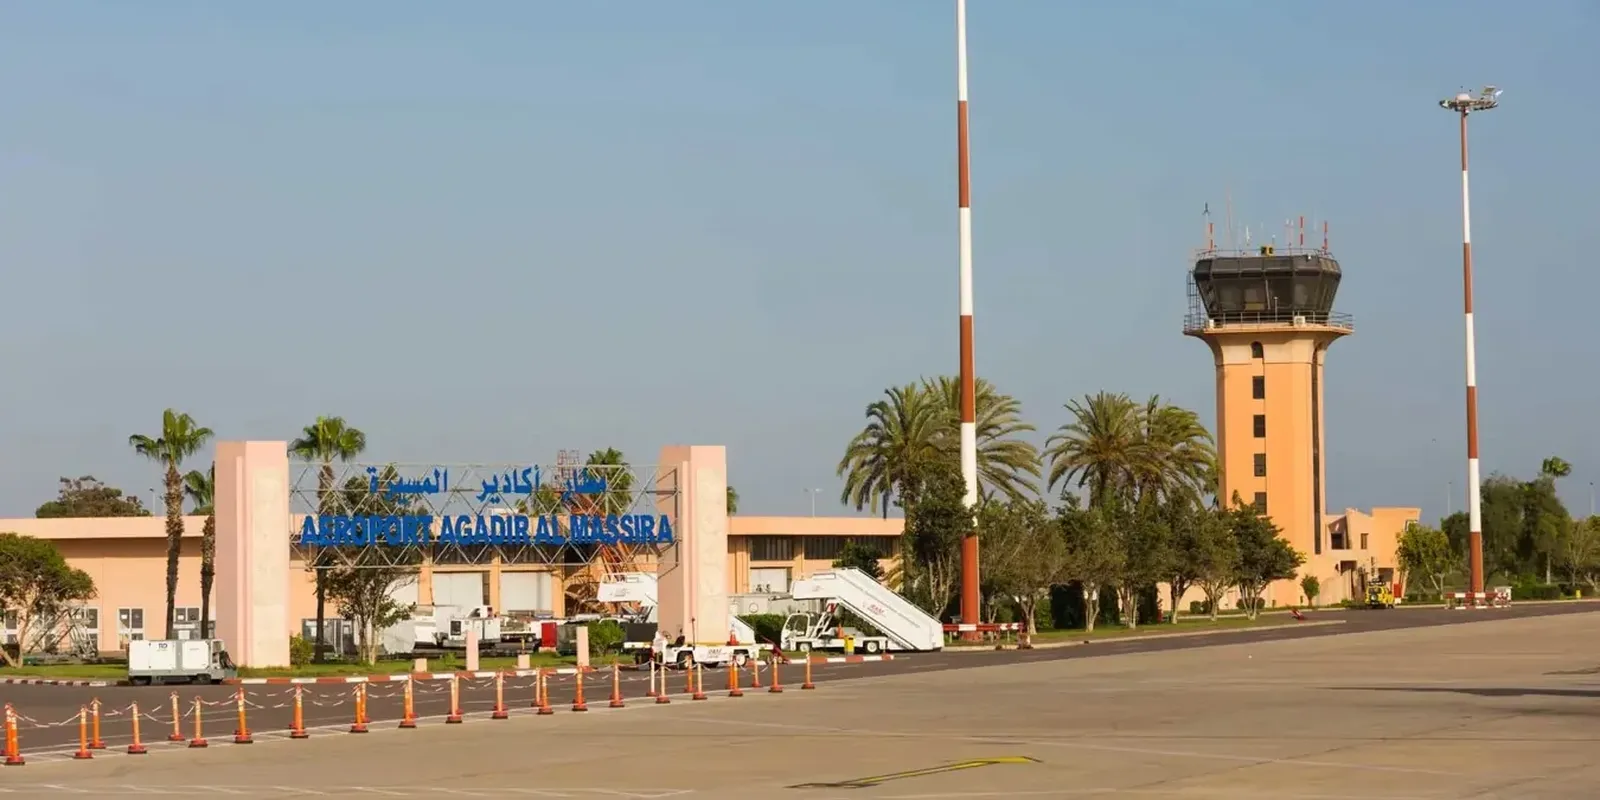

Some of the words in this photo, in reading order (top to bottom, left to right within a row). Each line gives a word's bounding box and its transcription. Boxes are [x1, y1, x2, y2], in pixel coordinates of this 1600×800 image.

[366, 467, 448, 504] المسيرة
[476, 465, 540, 504] أكادير
[562, 468, 607, 501] مطار
[300, 514, 433, 546] AEROPORT
[440, 514, 528, 545] AGADIR
[534, 514, 564, 545] AL
[570, 514, 674, 545] MASSIRA
